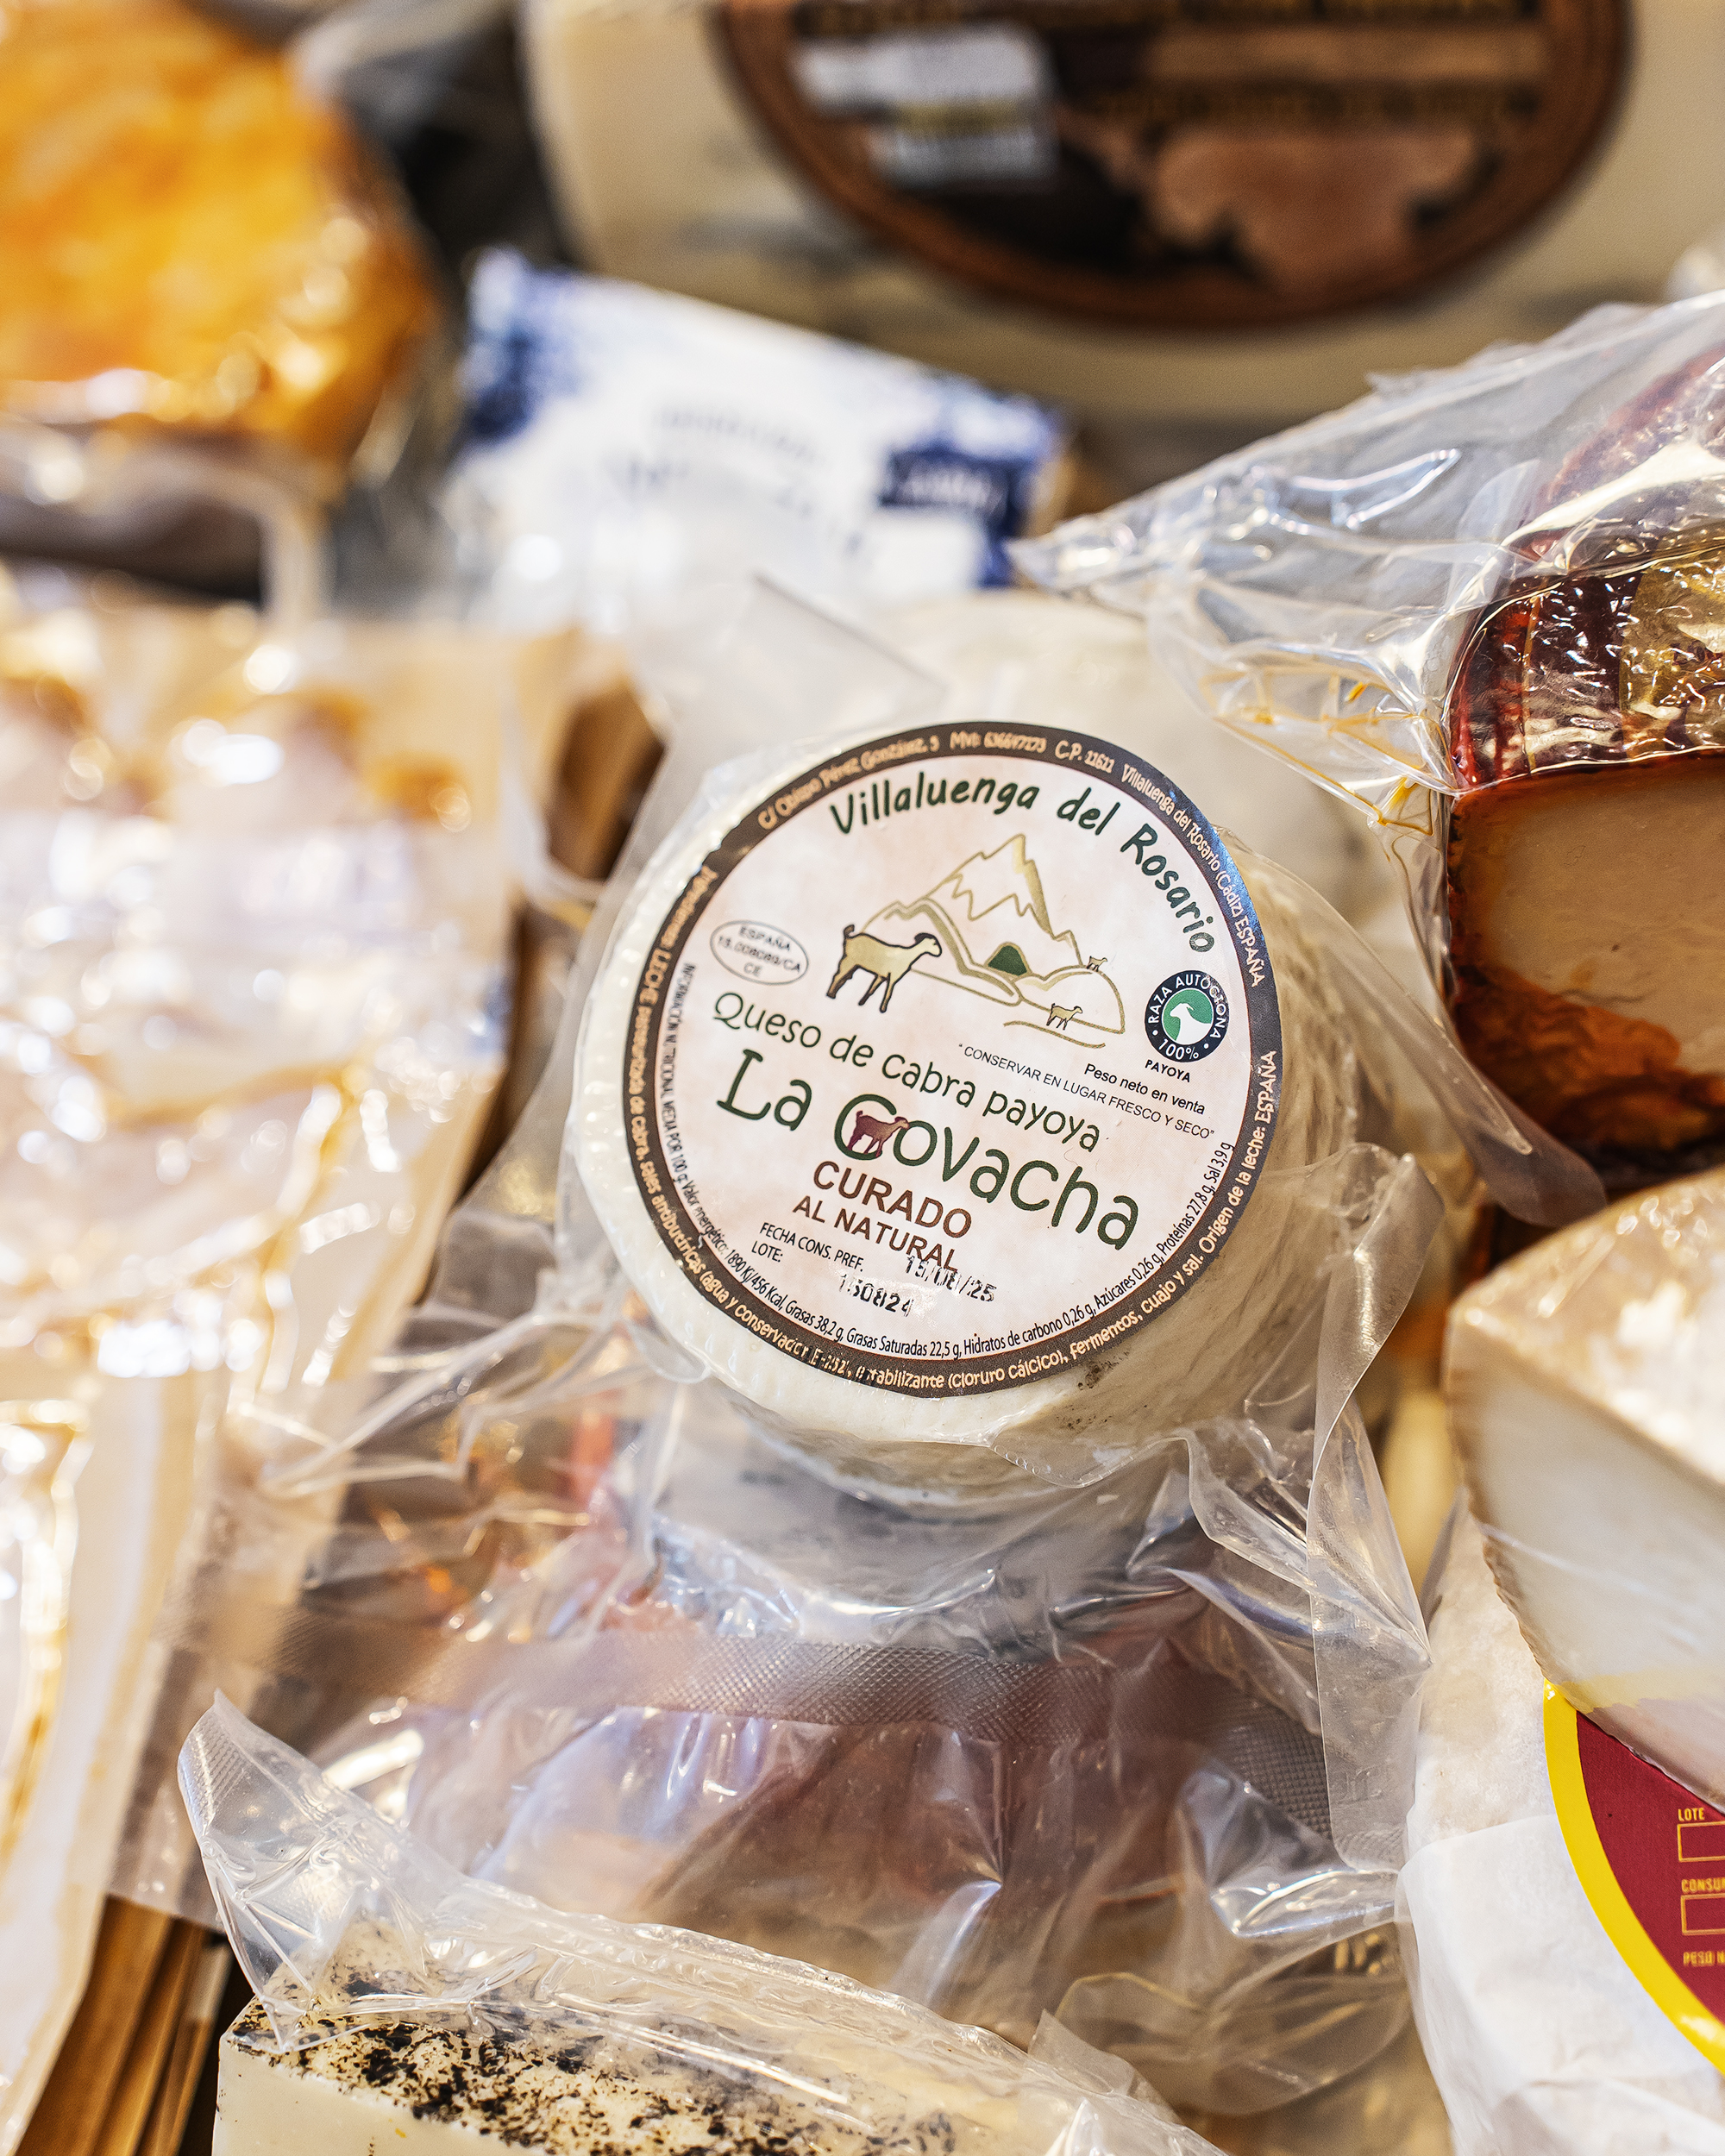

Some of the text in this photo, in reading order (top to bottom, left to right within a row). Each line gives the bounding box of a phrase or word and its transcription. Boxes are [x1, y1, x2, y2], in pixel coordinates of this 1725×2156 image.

[830, 771, 1215, 953] Villaluenga del Rosario
[1055, 740, 1082, 761] C.P.
[1120, 763, 1176, 816] Villaluenga
[1173, 809, 1192, 832] del
[1186, 822, 1221, 872] Rosario
[1234, 915, 1265, 987] ESPAÑA
[1148, 986, 1173, 1024] RAZA
[1158, 1038, 1200, 1061] 100%
[713, 991, 1101, 1153] Queso de cabra payoya
[1145, 1059, 1191, 1083] PAYOYA
[1043, 1073, 1063, 1088] EN
[1063, 1081, 1107, 1104] LUGAR
[1107, 1096, 1162, 1123] FRESCO
[1164, 1115, 1175, 1126] Y
[1083, 1062, 1206, 1116] Peso neto en venta
[1254, 1050, 1277, 1125] ESPAÑA
[629, 1096, 646, 1115] de
[666, 1132, 682, 1156] POR
[715, 1049, 1139, 1250] La Covacha
[1220, 1142, 1235, 1151] g
[1241, 1126, 1266, 1169] leche:
[671, 1154, 688, 1173] 100
[1210, 1150, 1229, 1169] 3,9
[640, 1161, 662, 1194] sales
[1203, 1165, 1222, 1184] Sal
[1235, 1170, 1252, 1186] la
[681, 1180, 700, 1206] Valor
[813, 1160, 972, 1239] CURADO
[1186, 1191, 1208, 1215] 27,8
[1201, 1184, 1216, 1198] g,
[1227, 1186, 1245, 1206] de
[792, 1195, 958, 1274] AL NATURAL
[1156, 1212, 1196, 1257] Proteínas
[1198, 1206, 1234, 1255] Origen
[751, 1240, 783, 1263] LOTE:
[759, 1222, 796, 1246] FECHA
[798, 1236, 831, 1261] CONS.
[833, 1250, 864, 1273] PREF.
[724, 1249, 747, 1272] 1890
[1131, 1257, 1154, 1281] 0,26
[1151, 1253, 1165, 1269] g,
[1182, 1253, 1204, 1276] sal.
[699, 1270, 731, 1304] (agua
[739, 1265, 770, 1294] Kj/456
[1172, 1270, 1186, 1286] y
[724, 1295, 738, 1310] y
[765, 1288, 789, 1312] Kcal,
[1094, 1275, 1136, 1310] Azúcares
[1140, 1279, 1177, 1314] cuajo
[785, 1300, 816, 1326] Grasas
[1062, 1305, 1085, 1327] 0,26
[1084, 1303, 1097, 1319] g,
[814, 1315, 837, 1336] 38,2
[836, 1326, 844, 1344] g,
[1022, 1318, 1063, 1342] carbono
[1070, 1310, 1144, 1361] fermentos,
[846, 1327, 877, 1351] Grasas
[879, 1335, 928, 1357] Saturadas
[930, 1341, 950, 1360] 22,5
[963, 1335, 1006, 1356] Hidratos
[1007, 1331, 1021, 1347] de
[952, 1344, 962, 1361] g,
[1007, 1350, 1069, 1379] cálcico),
[947, 1368, 1006, 1389] (cloruro
[1678, 1807, 1705, 1822] LOTE
[1683, 1951, 1715, 1967] PESO
